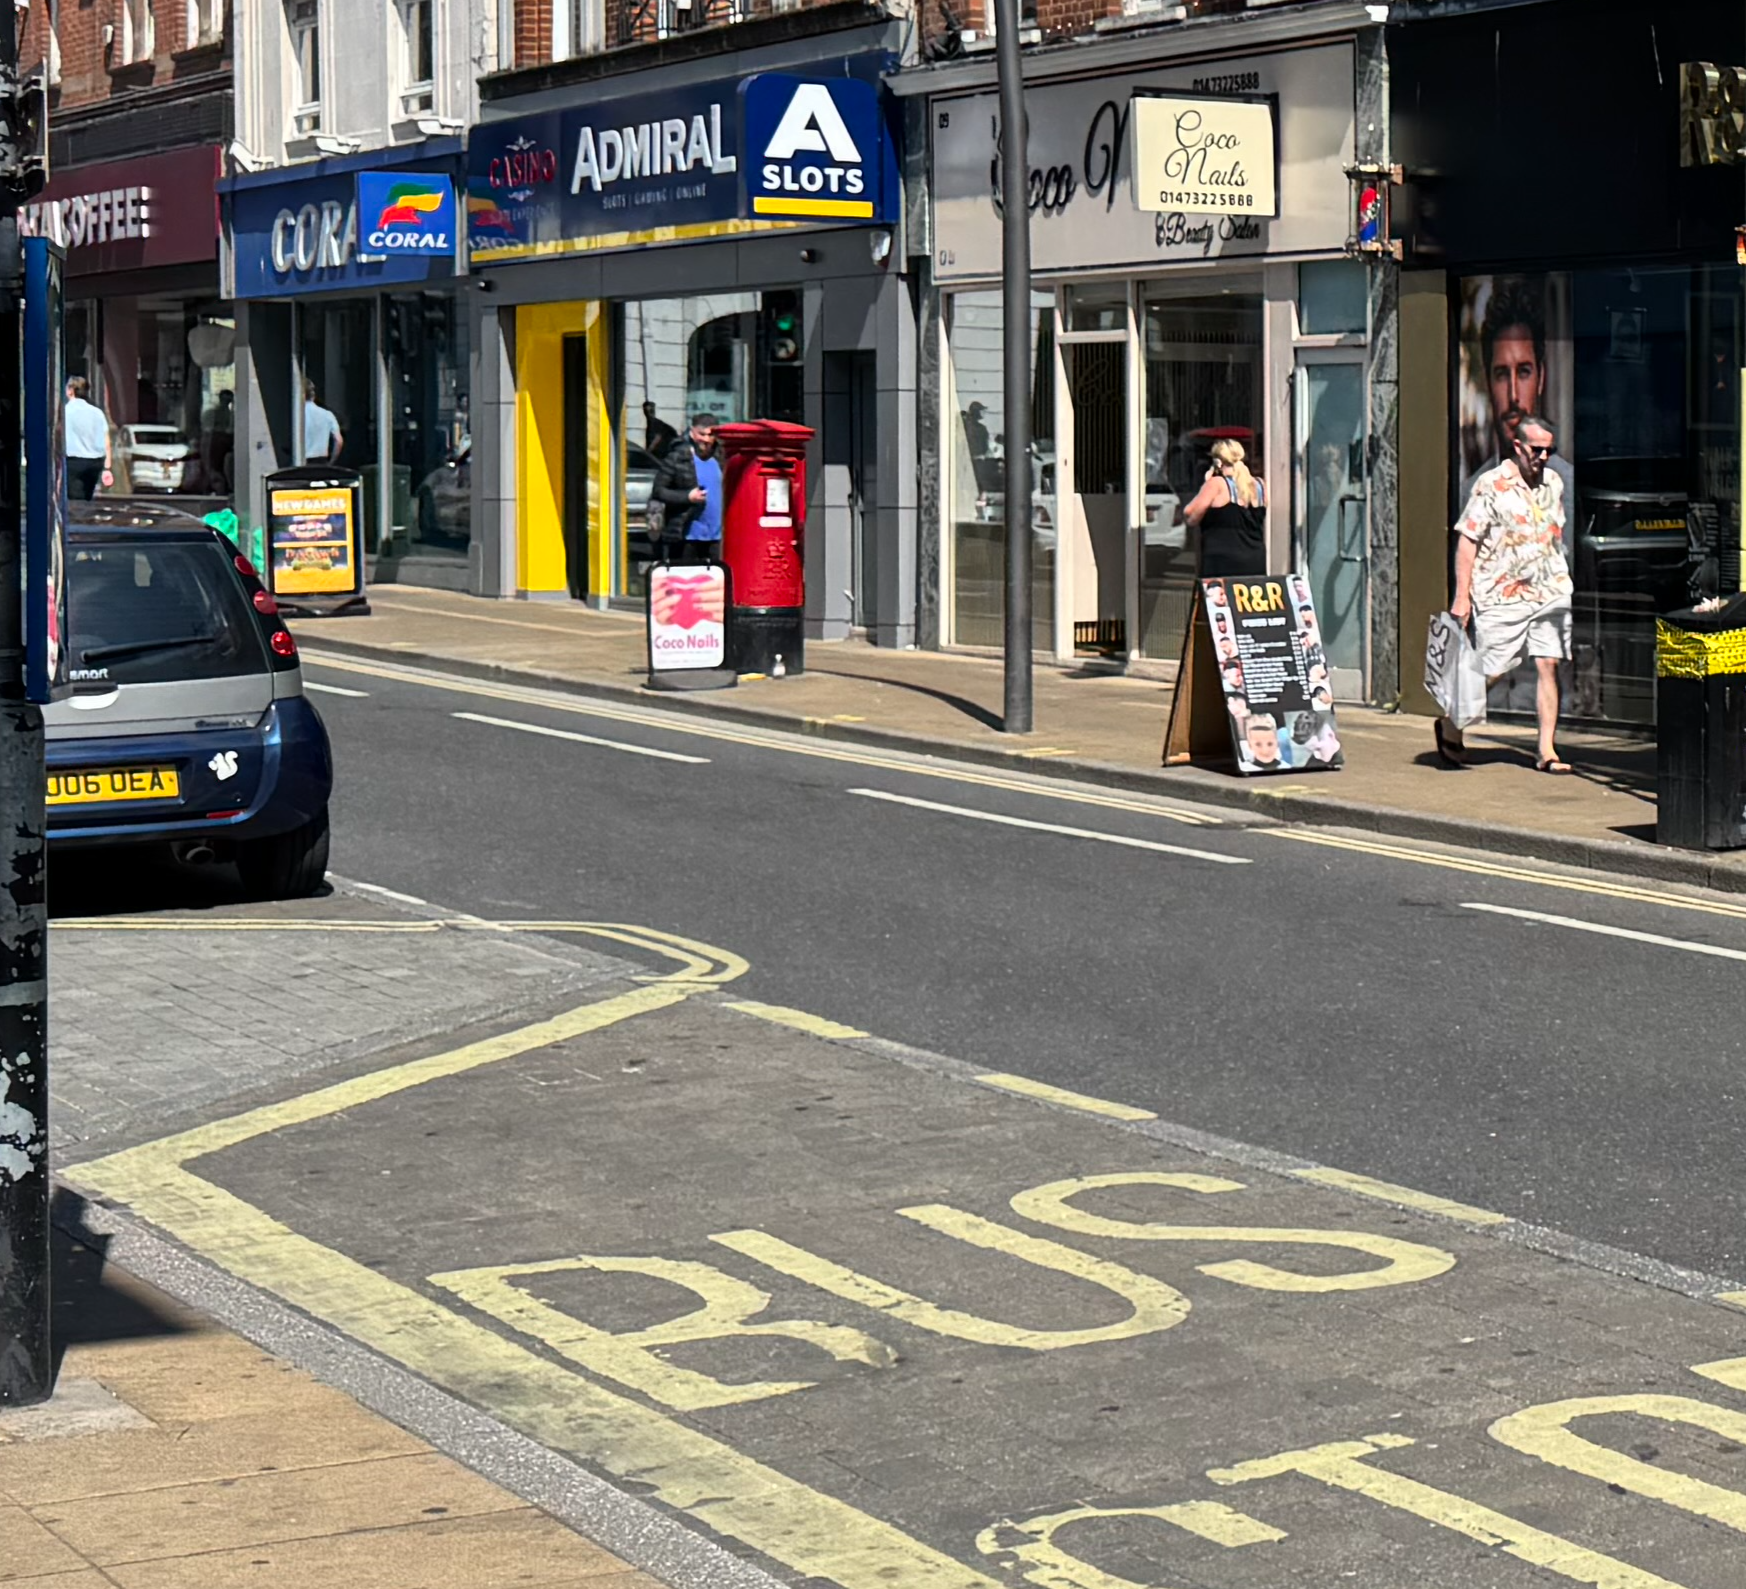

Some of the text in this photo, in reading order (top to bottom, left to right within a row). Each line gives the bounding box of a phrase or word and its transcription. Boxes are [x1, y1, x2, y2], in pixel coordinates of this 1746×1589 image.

[764, 83, 863, 163] A
[1174, 109, 1241, 149] Coco
[488, 148, 558, 191] CASINO
[570, 103, 738, 196] ADMIRAL
[1164, 147, 1249, 186] Nails
[762, 164, 865, 195] SLOTS
[1160, 190, 1253, 207] 01473225888
[56, 186, 151, 248] COFFEE
[271, 200, 388, 274] CORA
[368, 231, 449, 249] CORAL
[1232, 582, 1286, 614] R&R
[654, 632, 720, 650] Coco Nails
[1425, 616, 1451, 701] M&S
[429, 1170, 1454, 1412] BUS
